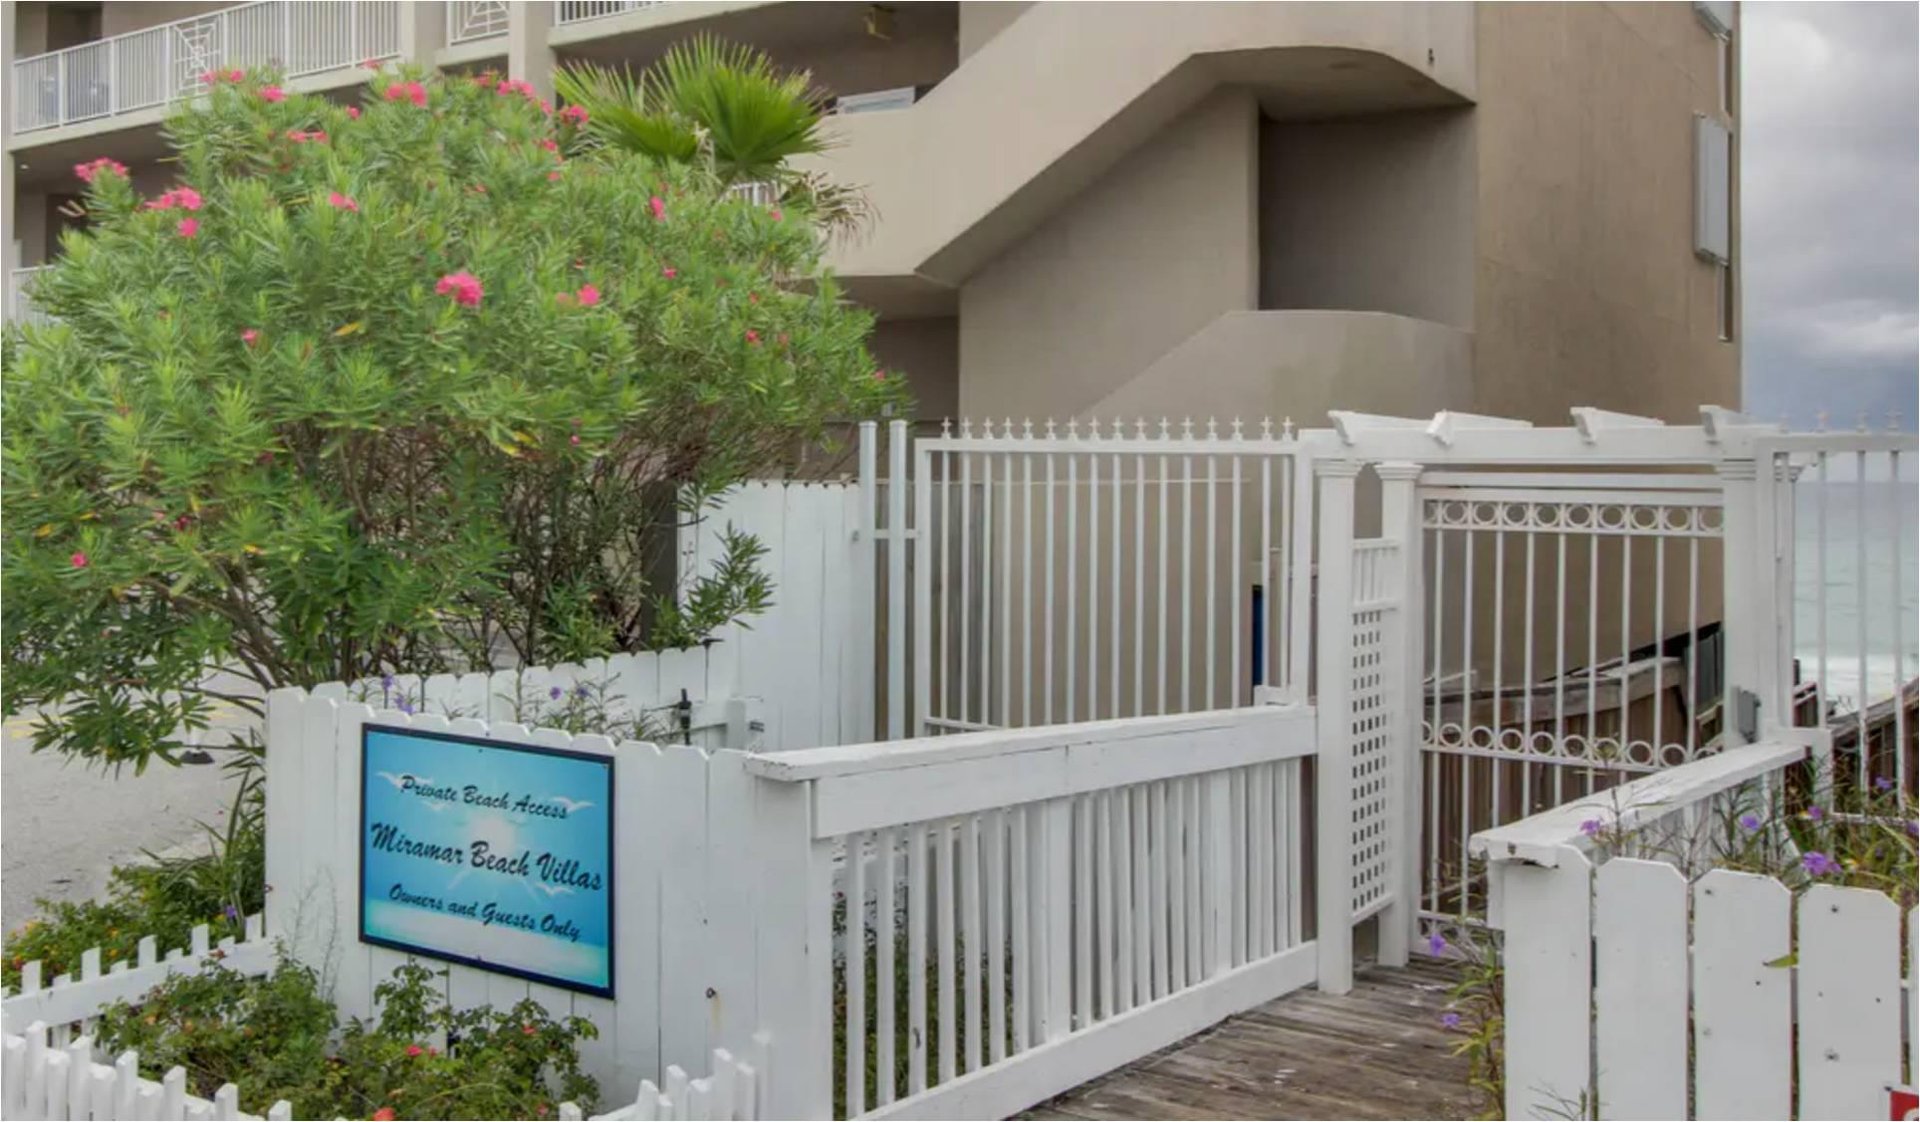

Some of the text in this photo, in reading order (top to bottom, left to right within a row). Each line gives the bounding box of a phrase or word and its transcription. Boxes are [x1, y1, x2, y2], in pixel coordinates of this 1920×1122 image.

[400, 775, 569, 819] Private Beach Access
[371, 822, 603, 891] Miramar Beach Villas
[389, 884, 582, 943] Owners and Guests Only
